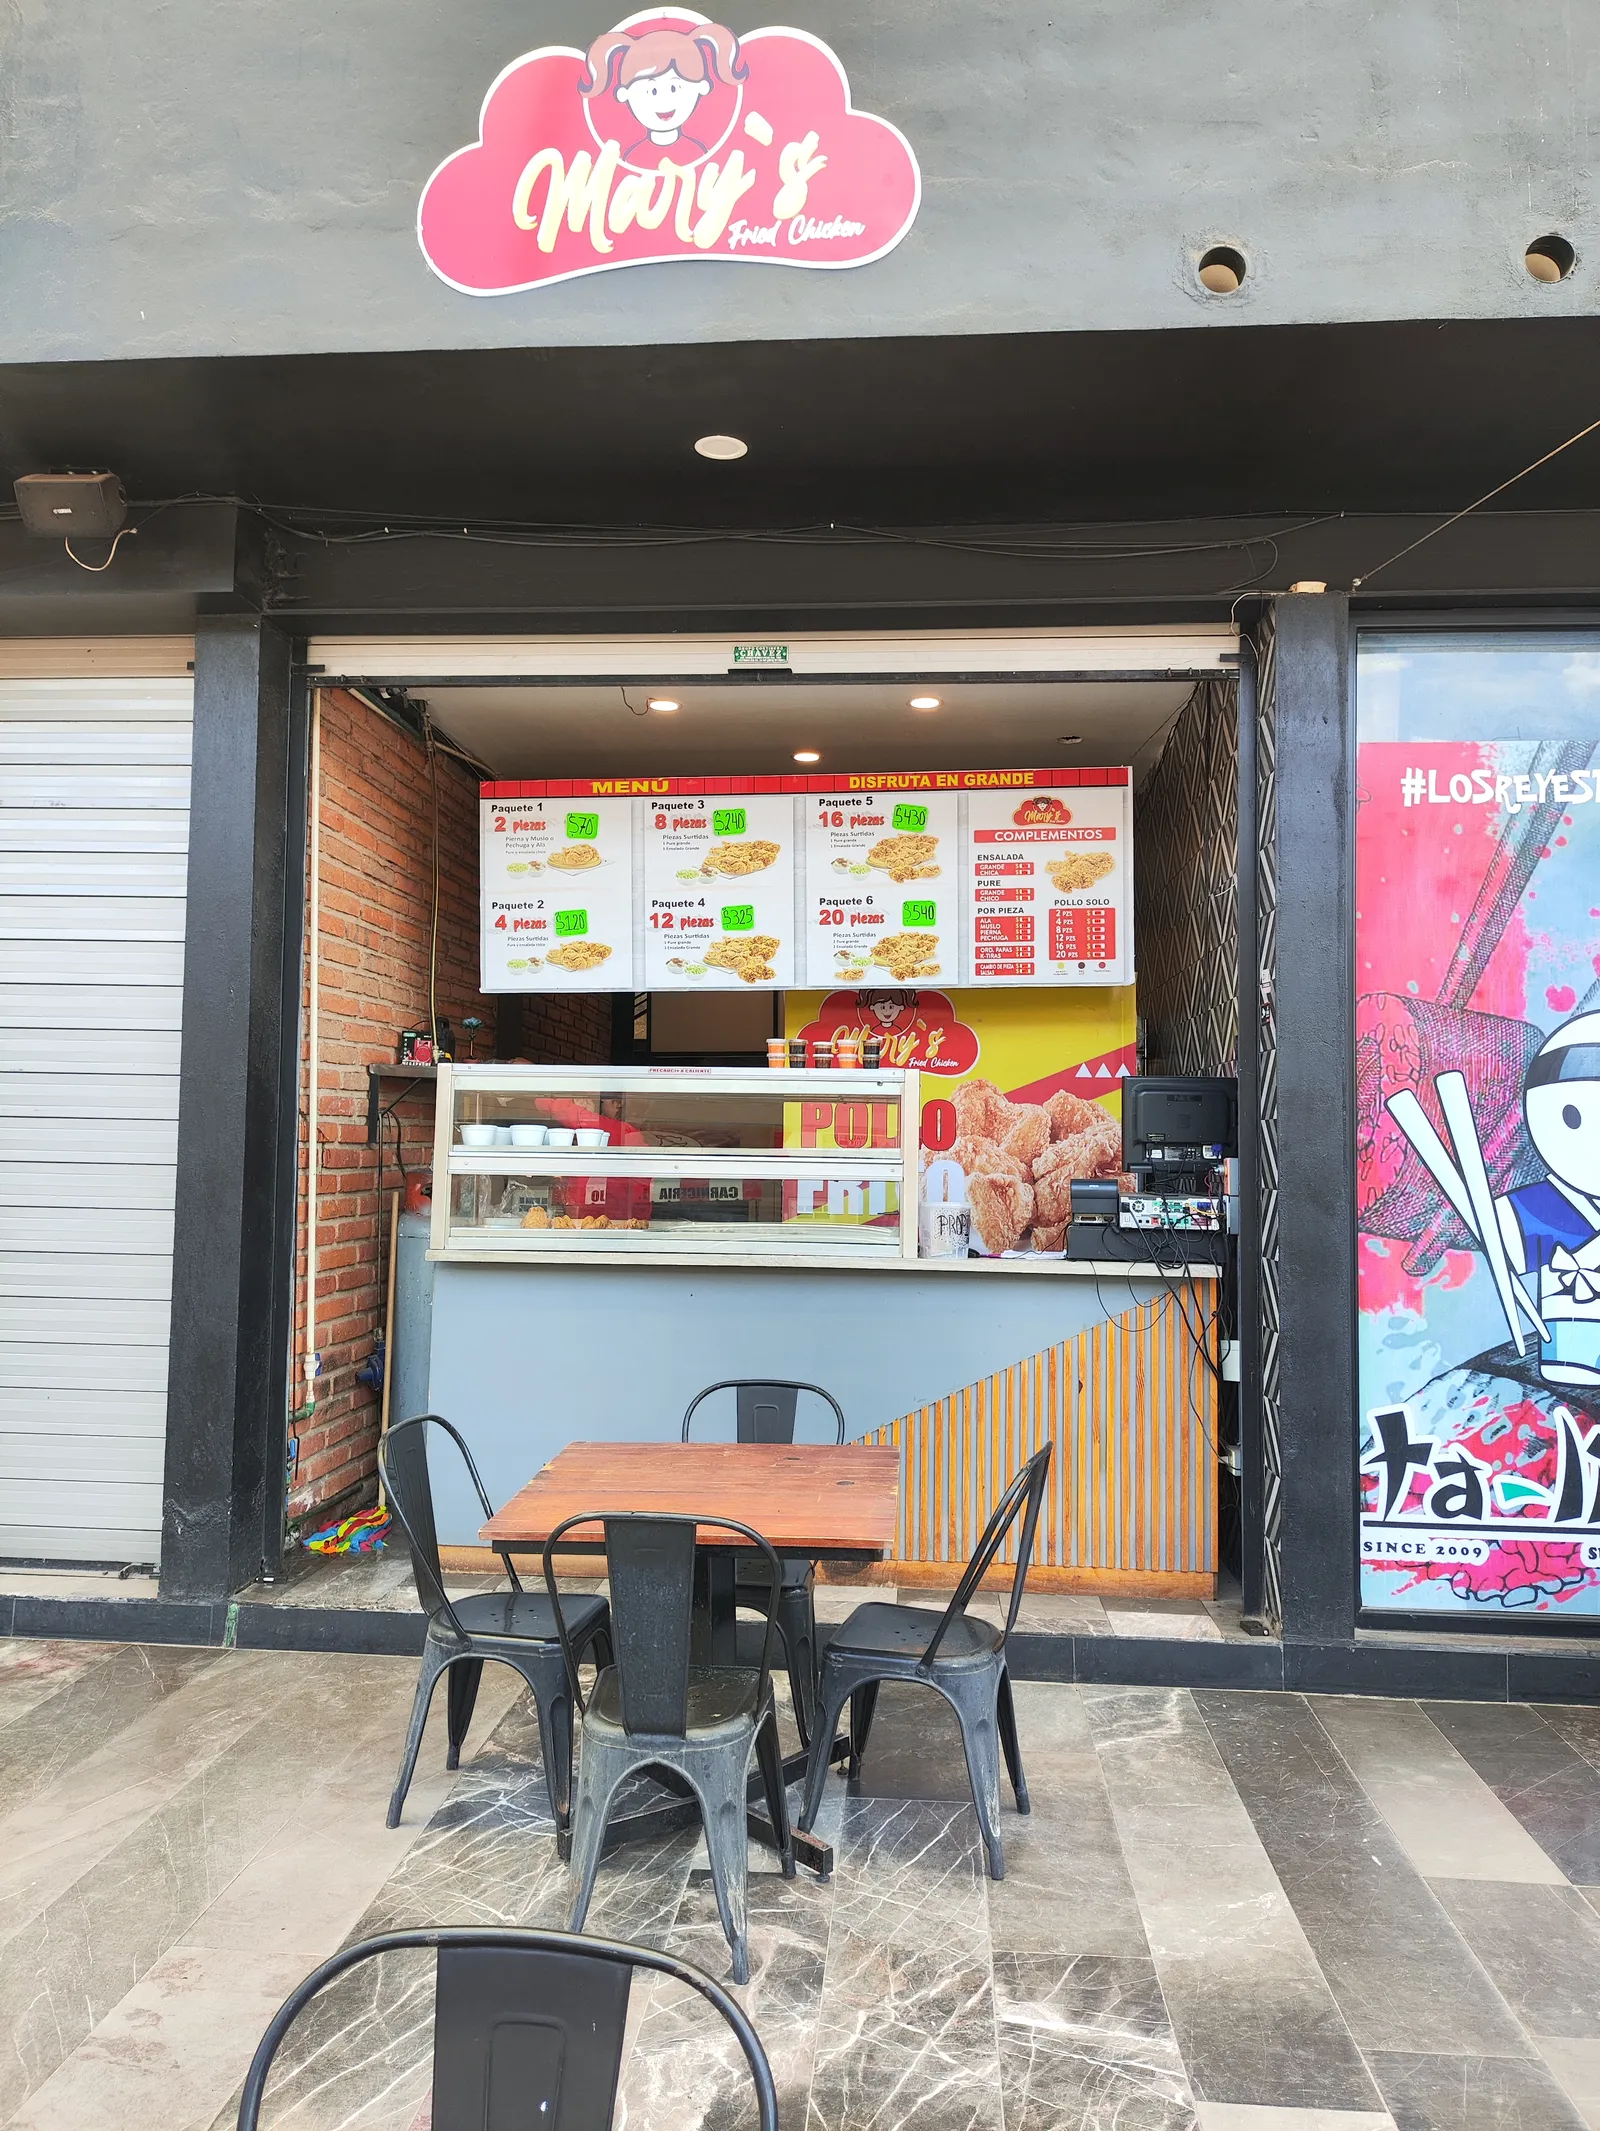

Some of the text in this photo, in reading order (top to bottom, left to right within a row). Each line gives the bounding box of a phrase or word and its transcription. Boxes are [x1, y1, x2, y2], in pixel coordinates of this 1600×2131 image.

[728, 214, 865, 250] Fried Chicken
[850, 772, 1034, 789] DISFRUTA EN GRANDE
[491, 802, 543, 814] Paquete 1
[651, 800, 705, 811] Paquete 3
[819, 796, 873, 808] Paquete 5
[494, 816, 547, 834] 2 piezas
[654, 813, 707, 832] 8 piezas
[818, 811, 885, 829] 16 piezas
[994, 829, 1103, 842] COMPLEMENTOS
[492, 900, 544, 911] Paquete 2
[652, 898, 705, 909] Paquete 4
[819, 896, 873, 907] Paquete 6
[494, 914, 547, 932] 4 piezas
[649, 912, 715, 931] 12 piezas
[819, 909, 885, 927] 20 piezas
[1056, 942, 1064, 950] 16
[831, 1018, 946, 1066] Mry's
[908, 1057, 959, 1068] Fried Chicken
[801, 1099, 957, 1151] POLO
[1362, 1541, 1482, 1558] SINCE 2009
